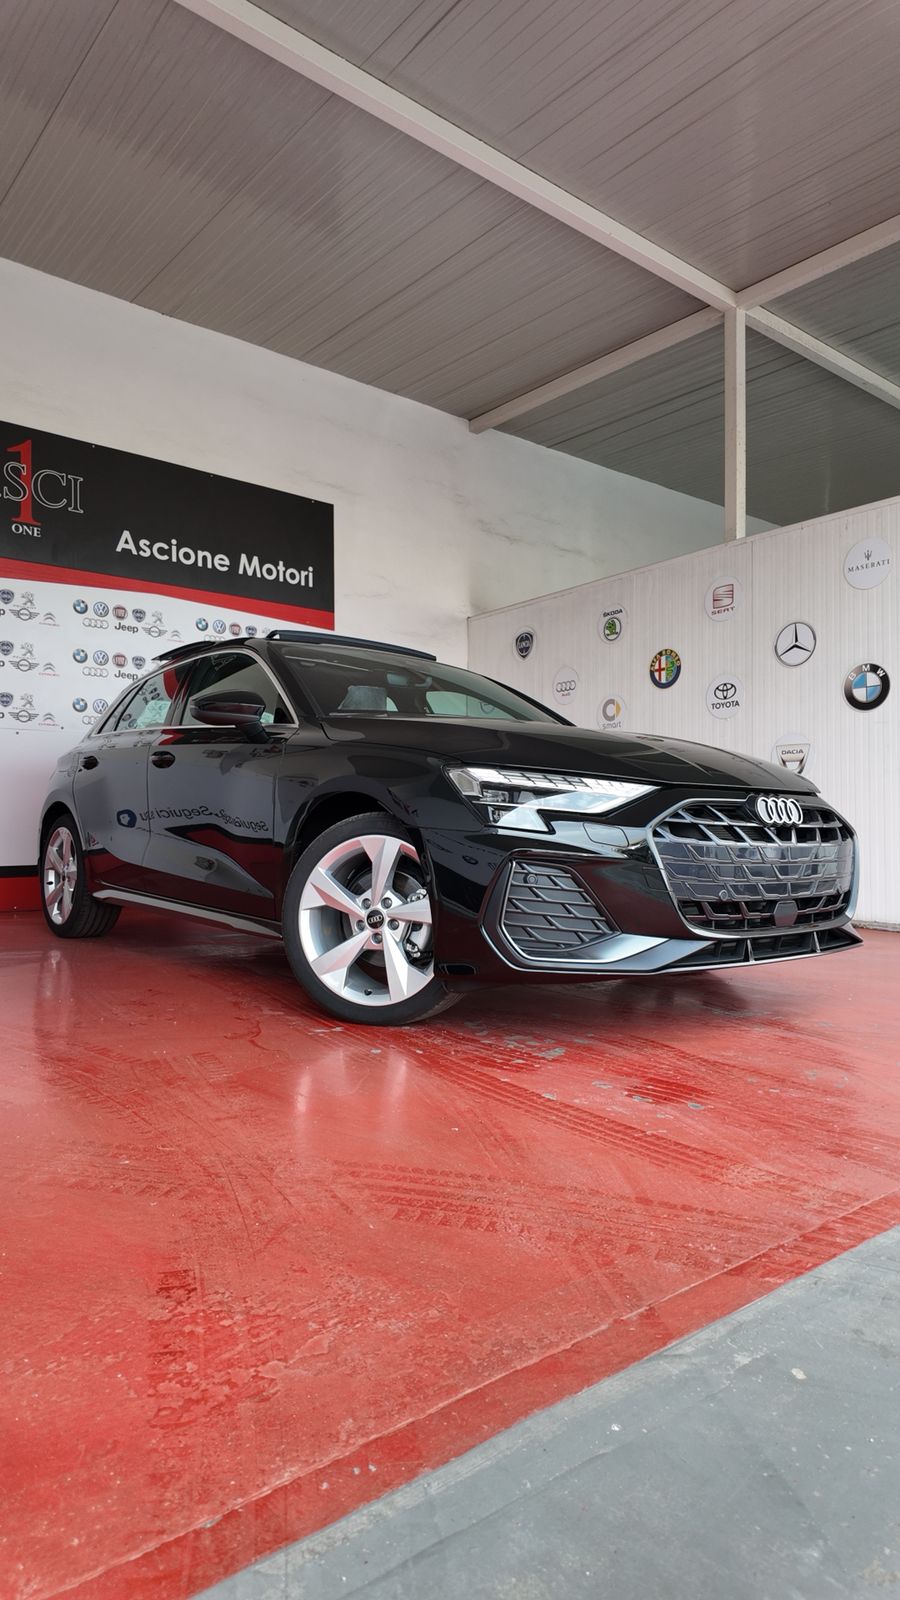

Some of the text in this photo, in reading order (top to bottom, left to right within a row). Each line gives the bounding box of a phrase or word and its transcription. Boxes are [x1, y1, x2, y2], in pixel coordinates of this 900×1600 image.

[0, 461, 84, 513] SCI
[11, 523, 42, 538] ONE
[115, 530, 314, 588] Ascione Motori
[848, 558, 890, 573] MASERATI
[711, 606, 735, 616] SEAT
[114, 622, 139, 634] Jeep
[114, 670, 139, 681] Jeep
[848, 664, 886, 681] BMW
[711, 700, 740, 710] TOYOTA
